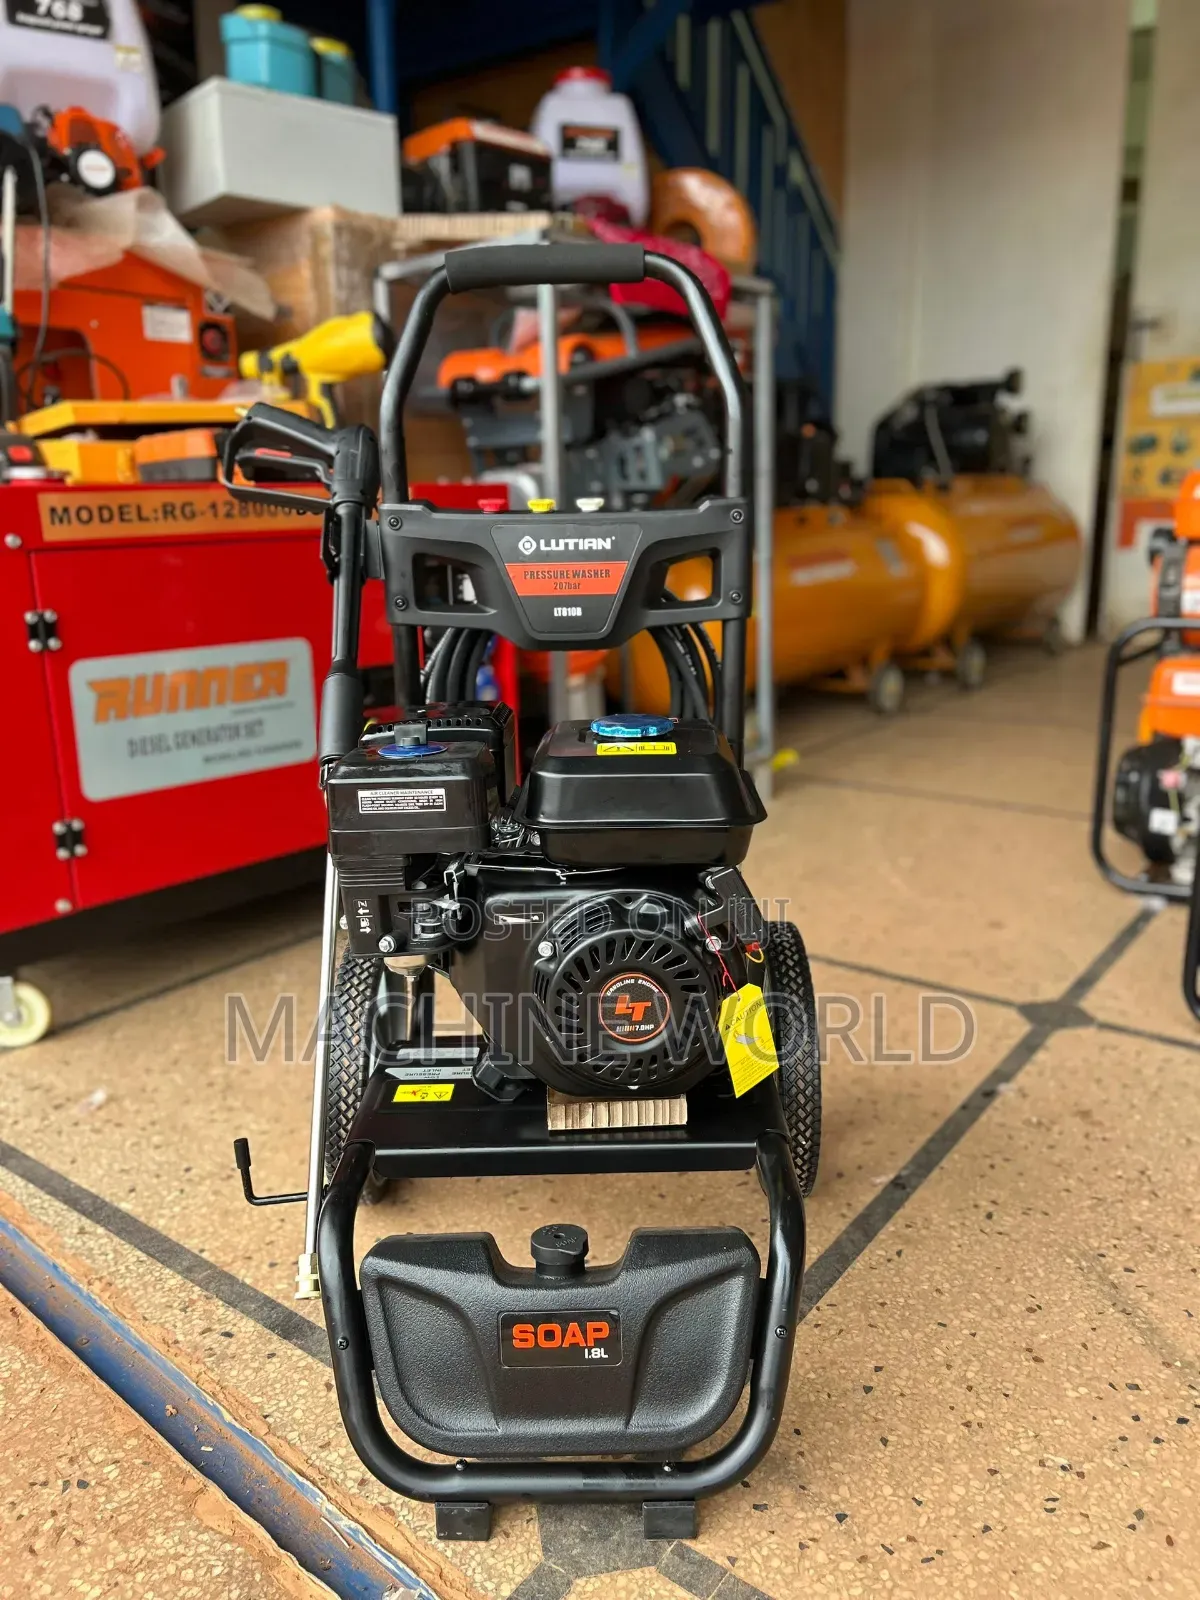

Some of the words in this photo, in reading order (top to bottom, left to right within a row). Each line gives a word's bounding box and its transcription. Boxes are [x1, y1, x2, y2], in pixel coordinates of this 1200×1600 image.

[540, 537, 612, 551] LUTIAN
[523, 569, 570, 580] PRESSURE
[572, 568, 611, 579] WASHER
[553, 581, 582, 590] 207bar
[87, 660, 288, 724] RUNNER
[127, 731, 172, 759] DIESEL
[174, 720, 237, 752] GENERATOR
[606, 978, 635, 997] GASOLINE
[637, 978, 660, 994] ENGINE
[615, 994, 652, 1021] LT
[730, 1000, 762, 1025] CAUTION
[512, 1321, 610, 1349] SOAP
[584, 1347, 609, 1359] 1.8L
